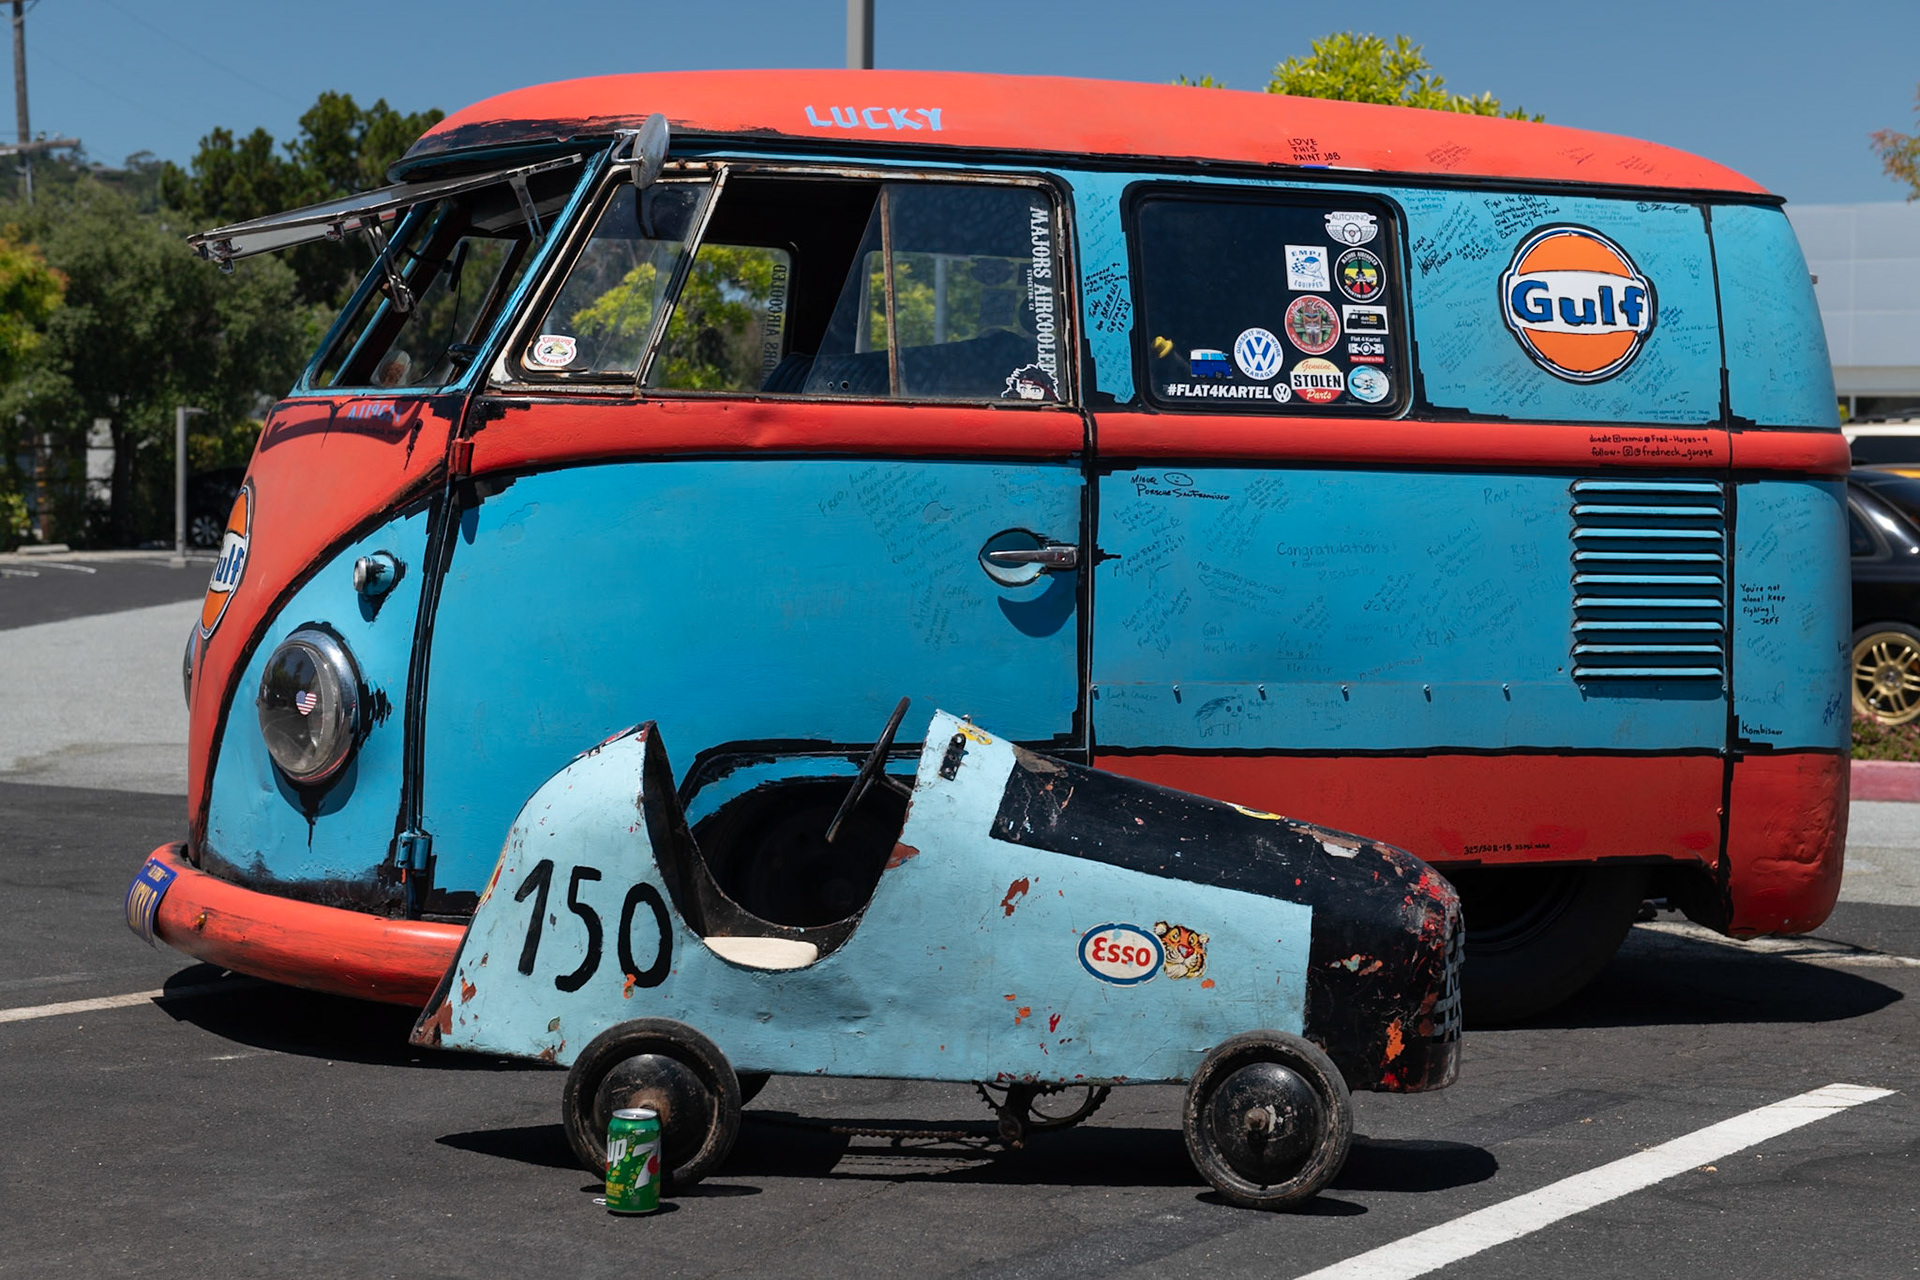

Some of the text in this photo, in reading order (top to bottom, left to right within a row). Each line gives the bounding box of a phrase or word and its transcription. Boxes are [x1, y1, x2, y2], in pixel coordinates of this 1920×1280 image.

[804, 105, 942, 131] LUCKY
[1287, 138, 1317, 146] LOVE
[1293, 152, 1320, 161] PAINT
[1029, 206, 1056, 376] MAJORS AIRCOOLED
[1511, 279, 1645, 327] Gulf
[1244, 367, 1275, 378] GARAGE
[1301, 360, 1332, 372] Genuine
[1293, 374, 1341, 388] STOLEN
[1167, 383, 1272, 399] #FLAT4KARTEL
[1306, 389, 1332, 400] Parts
[213, 543, 245, 585] ulf
[1740, 583, 1763, 593] You're
[514, 859, 673, 993] 150
